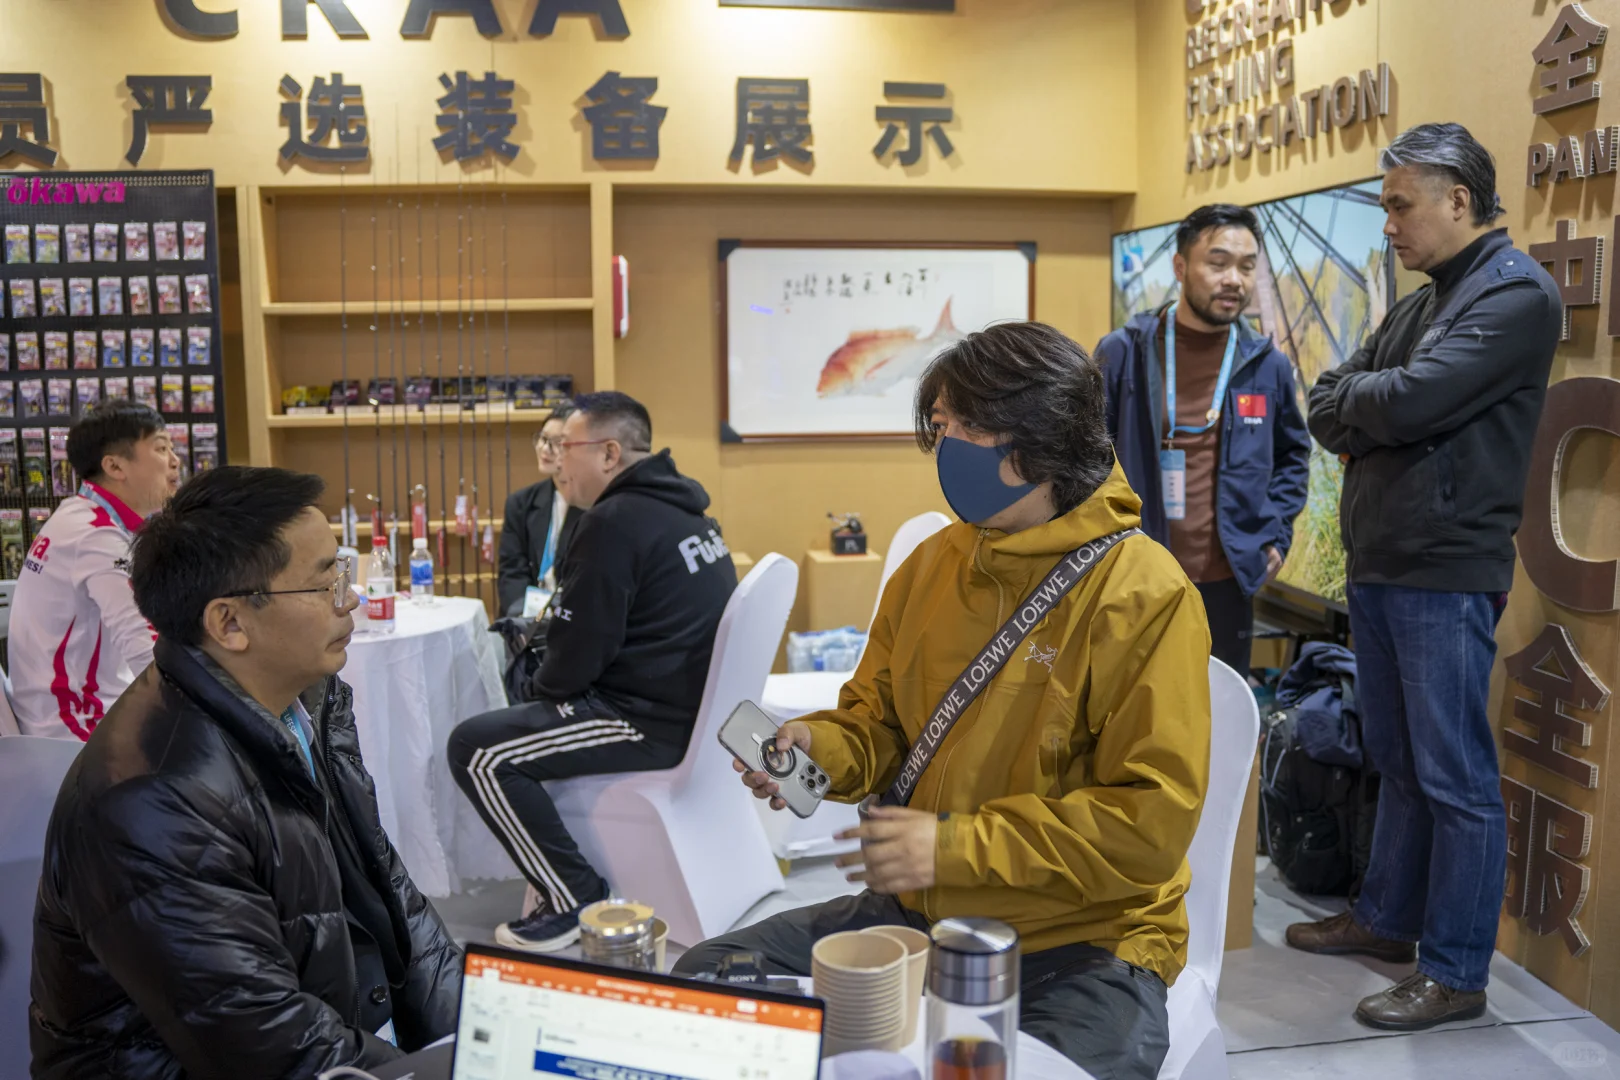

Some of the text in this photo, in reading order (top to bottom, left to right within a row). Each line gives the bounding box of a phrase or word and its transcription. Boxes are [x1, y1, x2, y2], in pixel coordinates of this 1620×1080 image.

[1186, 39, 1294, 121] FISHING
[1531, 3, 1609, 115] 全
[0, 71, 954, 166] 员严选装备展示
[1186, 62, 1390, 174] ASSOCIATION
[1529, 217, 1620, 341] 中
[895, 743, 928, 797] LOEWE
[924, 689, 965, 748] LOEWE
[962, 630, 1016, 693] LOEWE
[1012, 570, 1070, 634] LOEWE
[1504, 622, 1611, 788] 全
